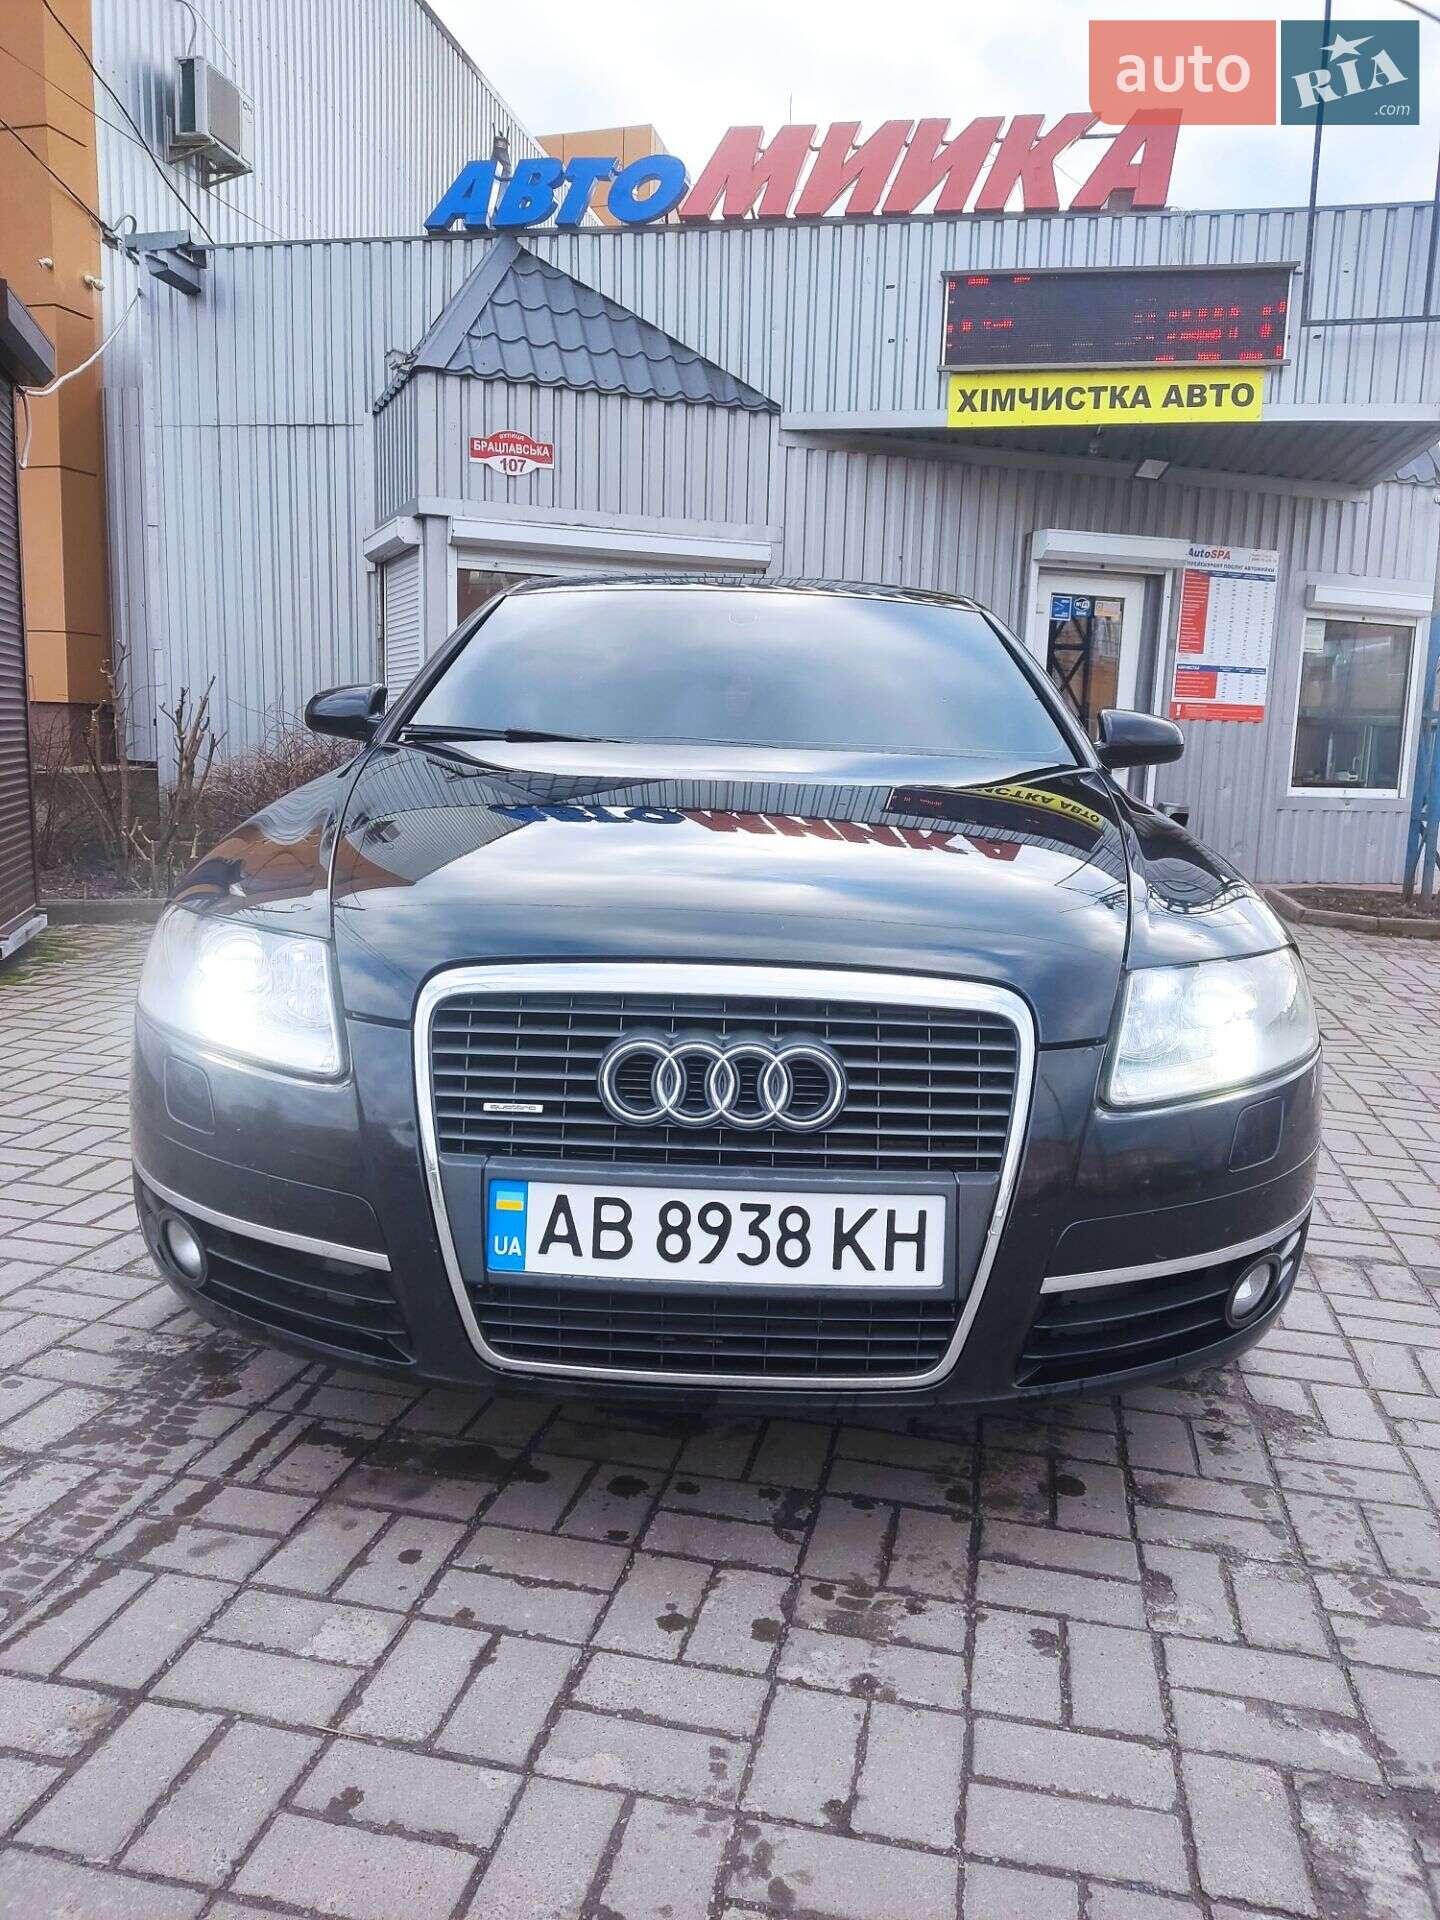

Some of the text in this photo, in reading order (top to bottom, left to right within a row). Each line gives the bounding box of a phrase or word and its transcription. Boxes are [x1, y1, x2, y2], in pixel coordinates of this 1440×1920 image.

[956, 382, 1256, 413] ХІМЧИСТКА АВТО
[473, 439, 551, 458] БРАЦЛАВСЬКА
[500, 457, 527, 472] 107
[1187, 547, 1231, 560] AutoSPA
[494, 1235, 522, 1257] UA
[656, 1200, 812, 1268] 8938
